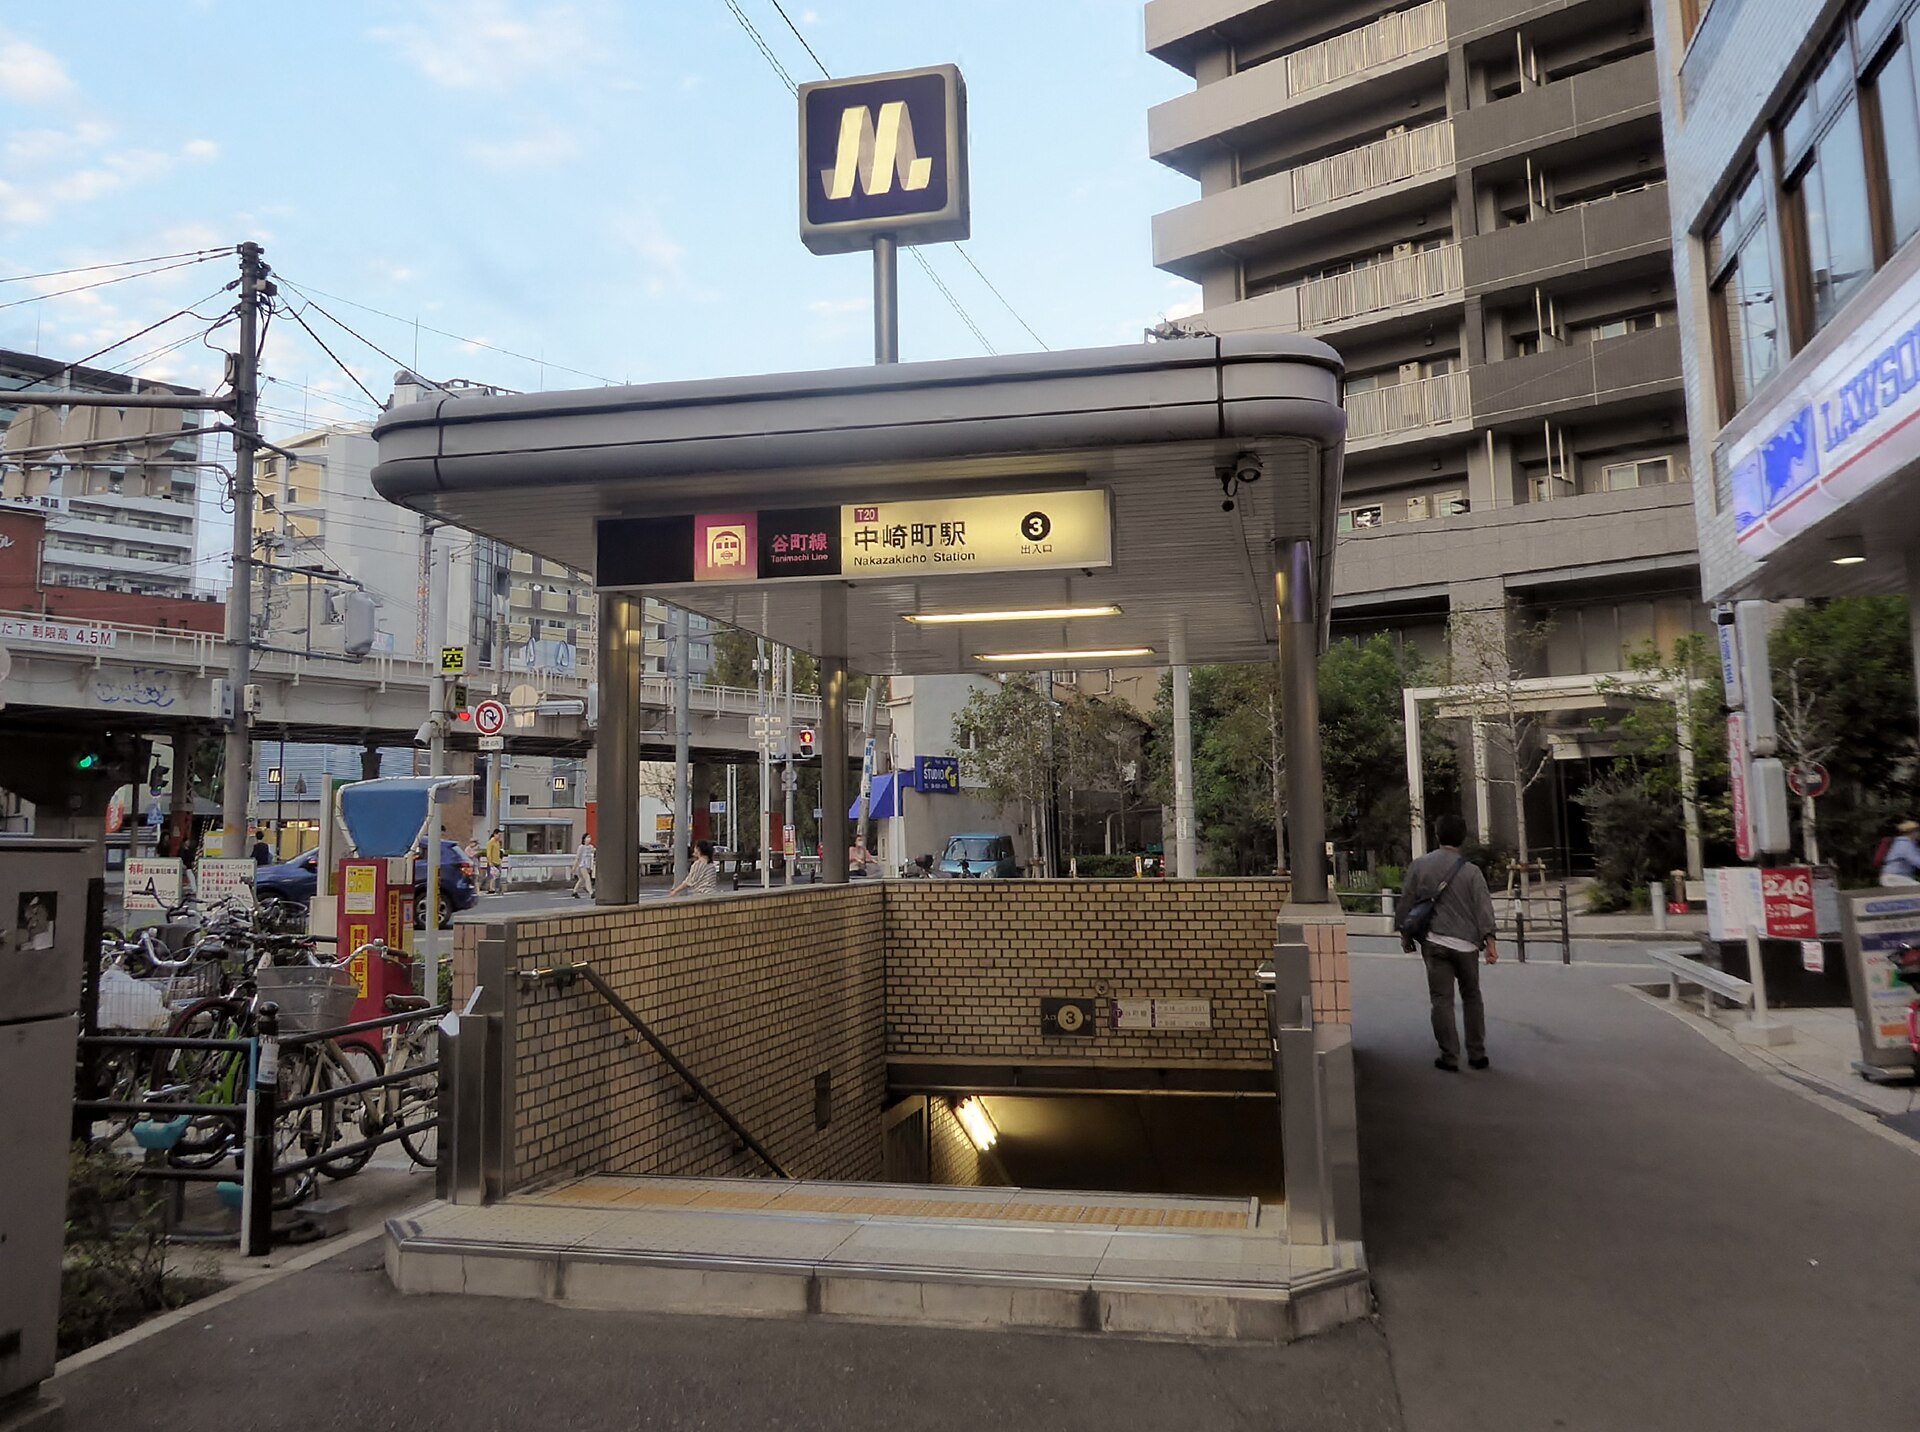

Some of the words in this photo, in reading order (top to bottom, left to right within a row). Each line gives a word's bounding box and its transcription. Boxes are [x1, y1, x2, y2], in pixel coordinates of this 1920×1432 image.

[1821, 321, 1920, 453] LAWSO
[857, 508, 876, 521] T20
[1028, 517, 1043, 536] 3
[771, 532, 828, 553] 谷町線
[854, 521, 966, 552] 中崎町駅
[770, 554, 810, 563] Tanimachi
[811, 553, 829, 561] Line
[854, 552, 927, 567] Nakazakicho
[933, 551, 976, 563] Station
[1020, 544, 1053, 555] 出入口
[32, 624, 69, 641] 制限高
[76, 629, 111, 646] 4.5M
[1763, 874, 1810, 900] 246
[1065, 1011, 1076, 1025] 3
